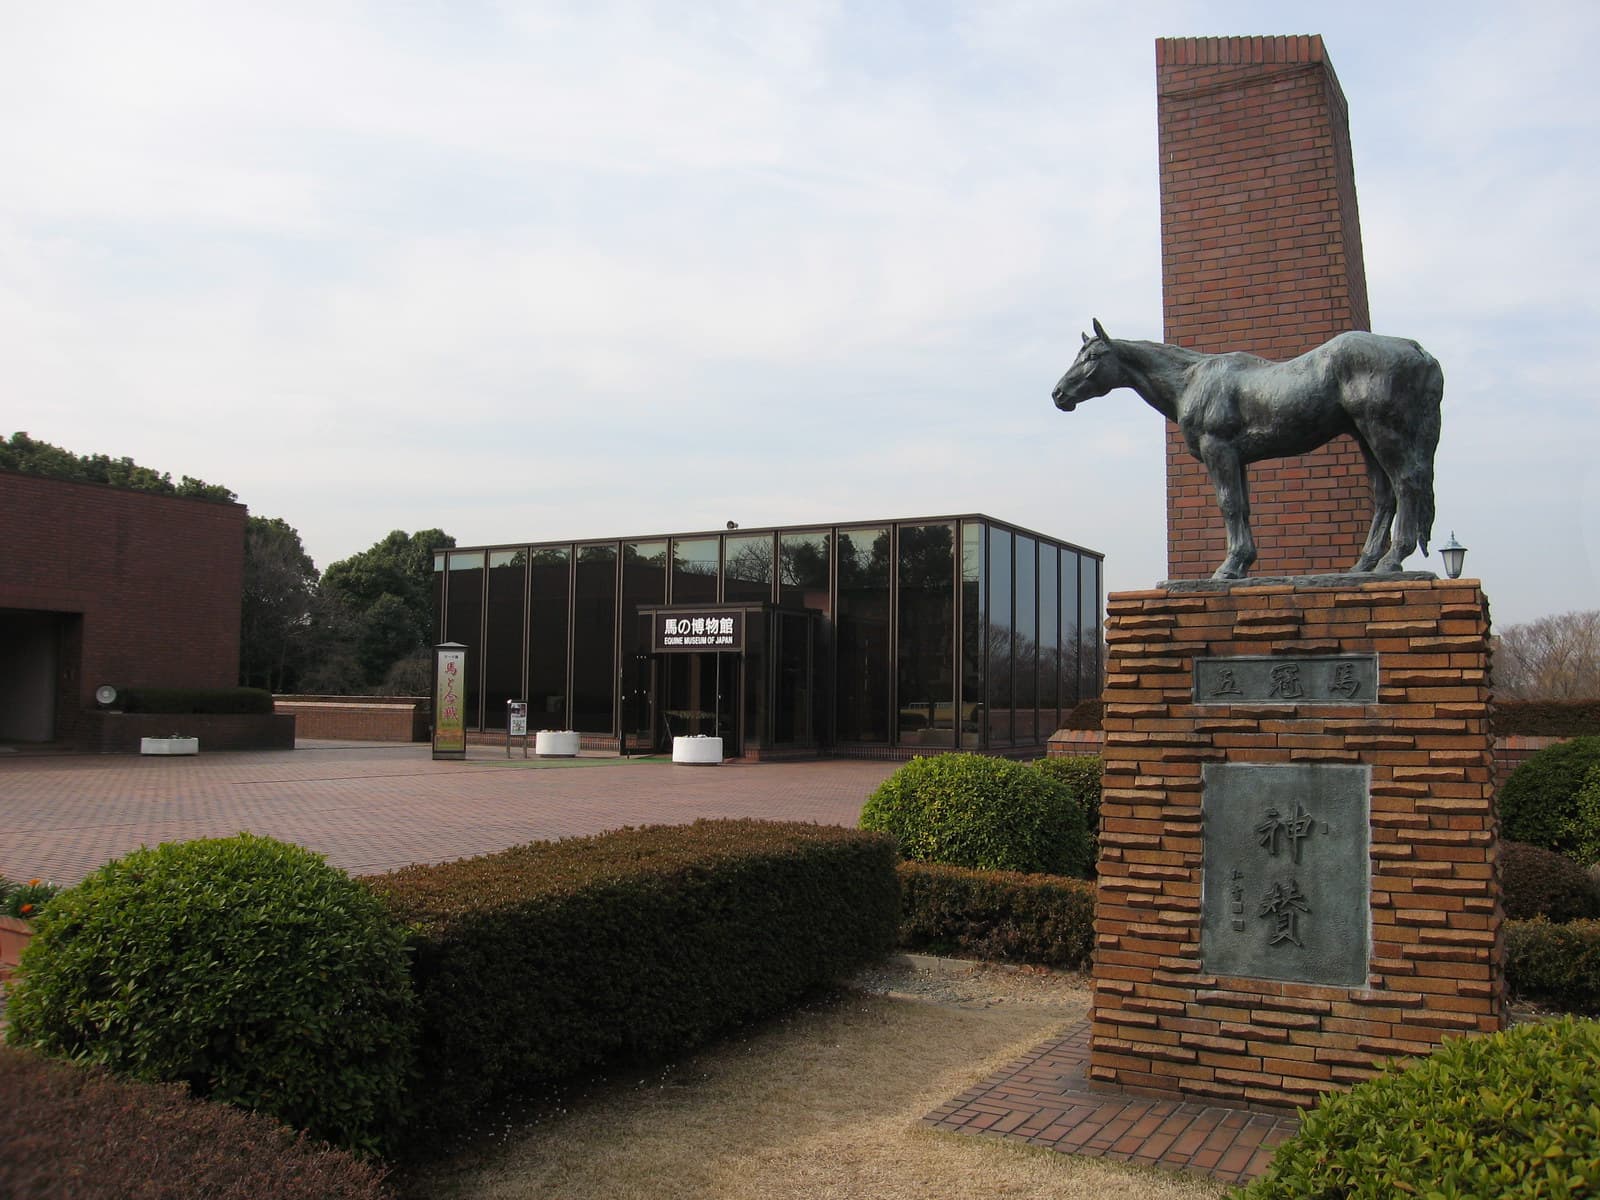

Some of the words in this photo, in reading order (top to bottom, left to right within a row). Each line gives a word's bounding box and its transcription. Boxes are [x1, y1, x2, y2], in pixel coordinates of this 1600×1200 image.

[664, 617, 734, 635] 馬の博物館
[664, 637, 683, 645] EQUINE
[684, 637, 707, 645] MUSEUM
[707, 636, 715, 644] OF
[715, 636, 733, 644] JAPAN
